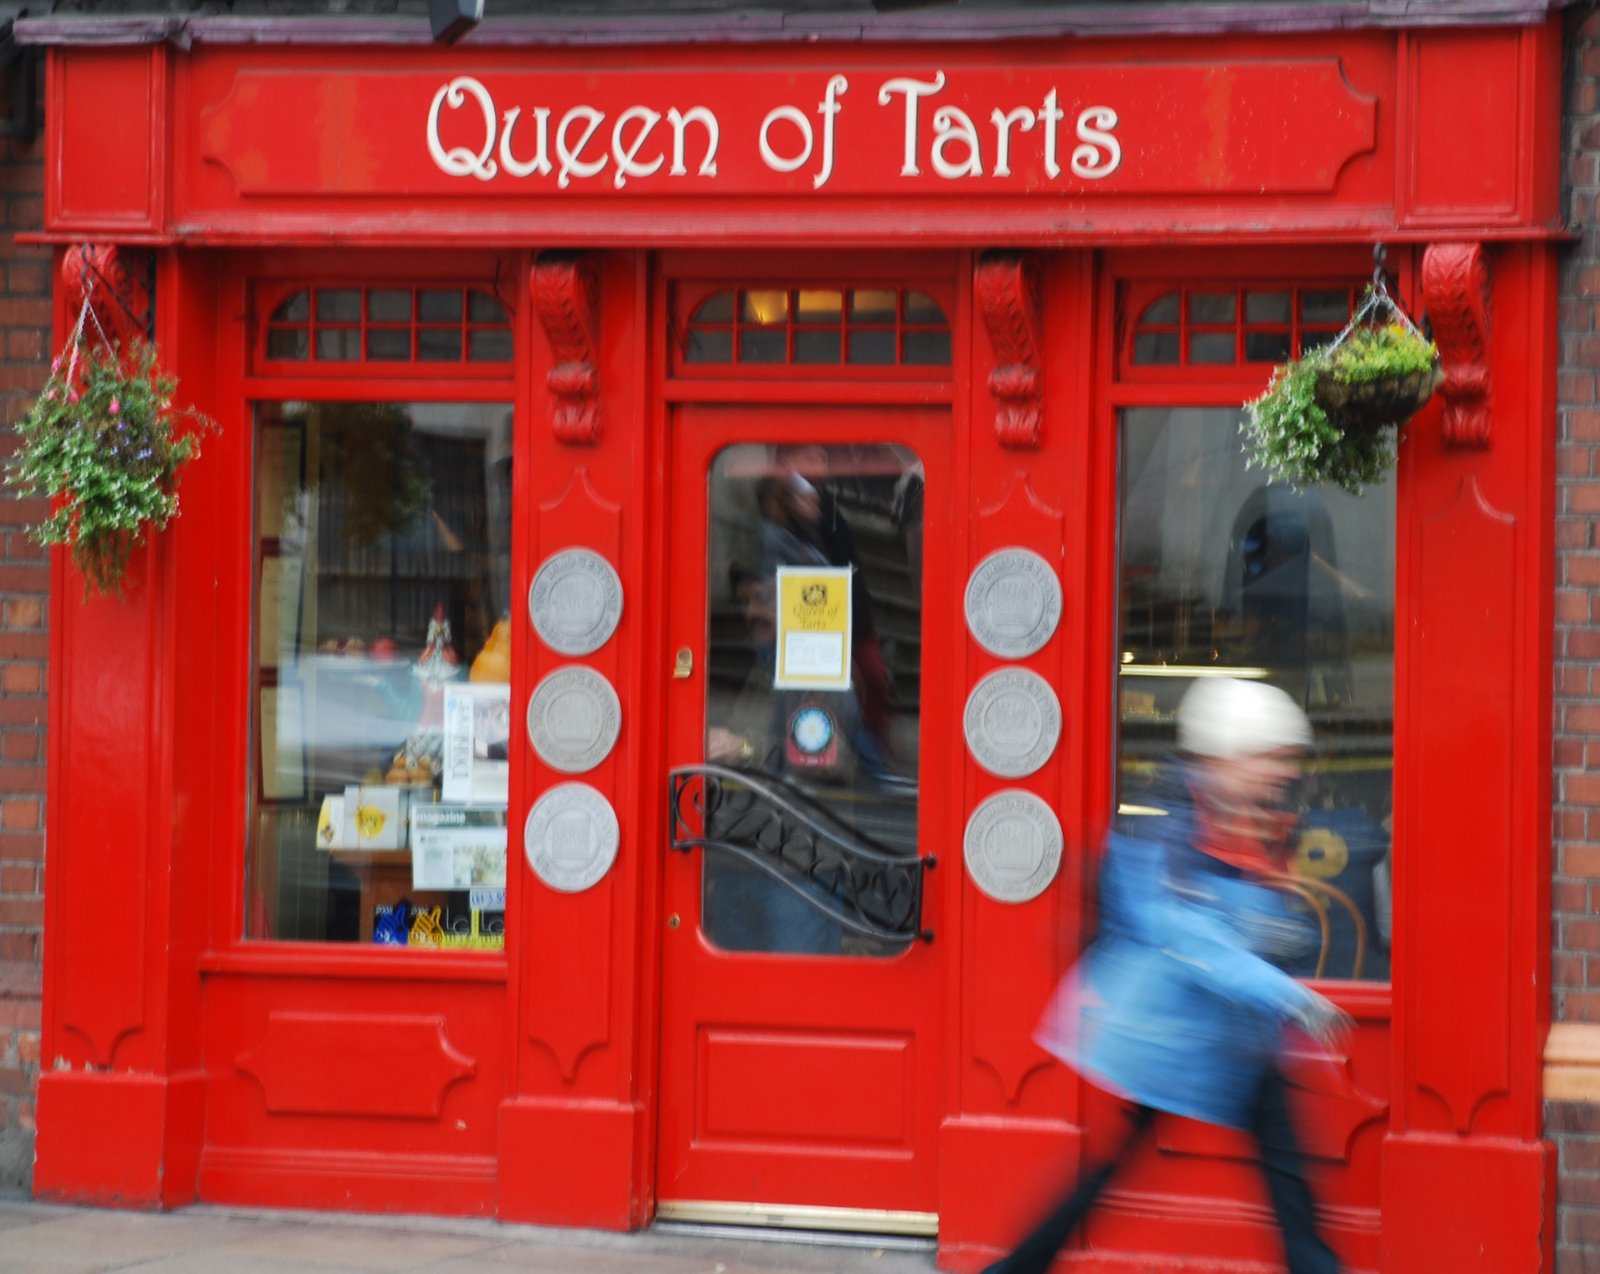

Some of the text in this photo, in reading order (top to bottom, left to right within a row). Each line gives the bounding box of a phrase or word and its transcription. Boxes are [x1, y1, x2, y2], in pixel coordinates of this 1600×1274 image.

[427, 70, 1121, 189] Queen of Tarts
